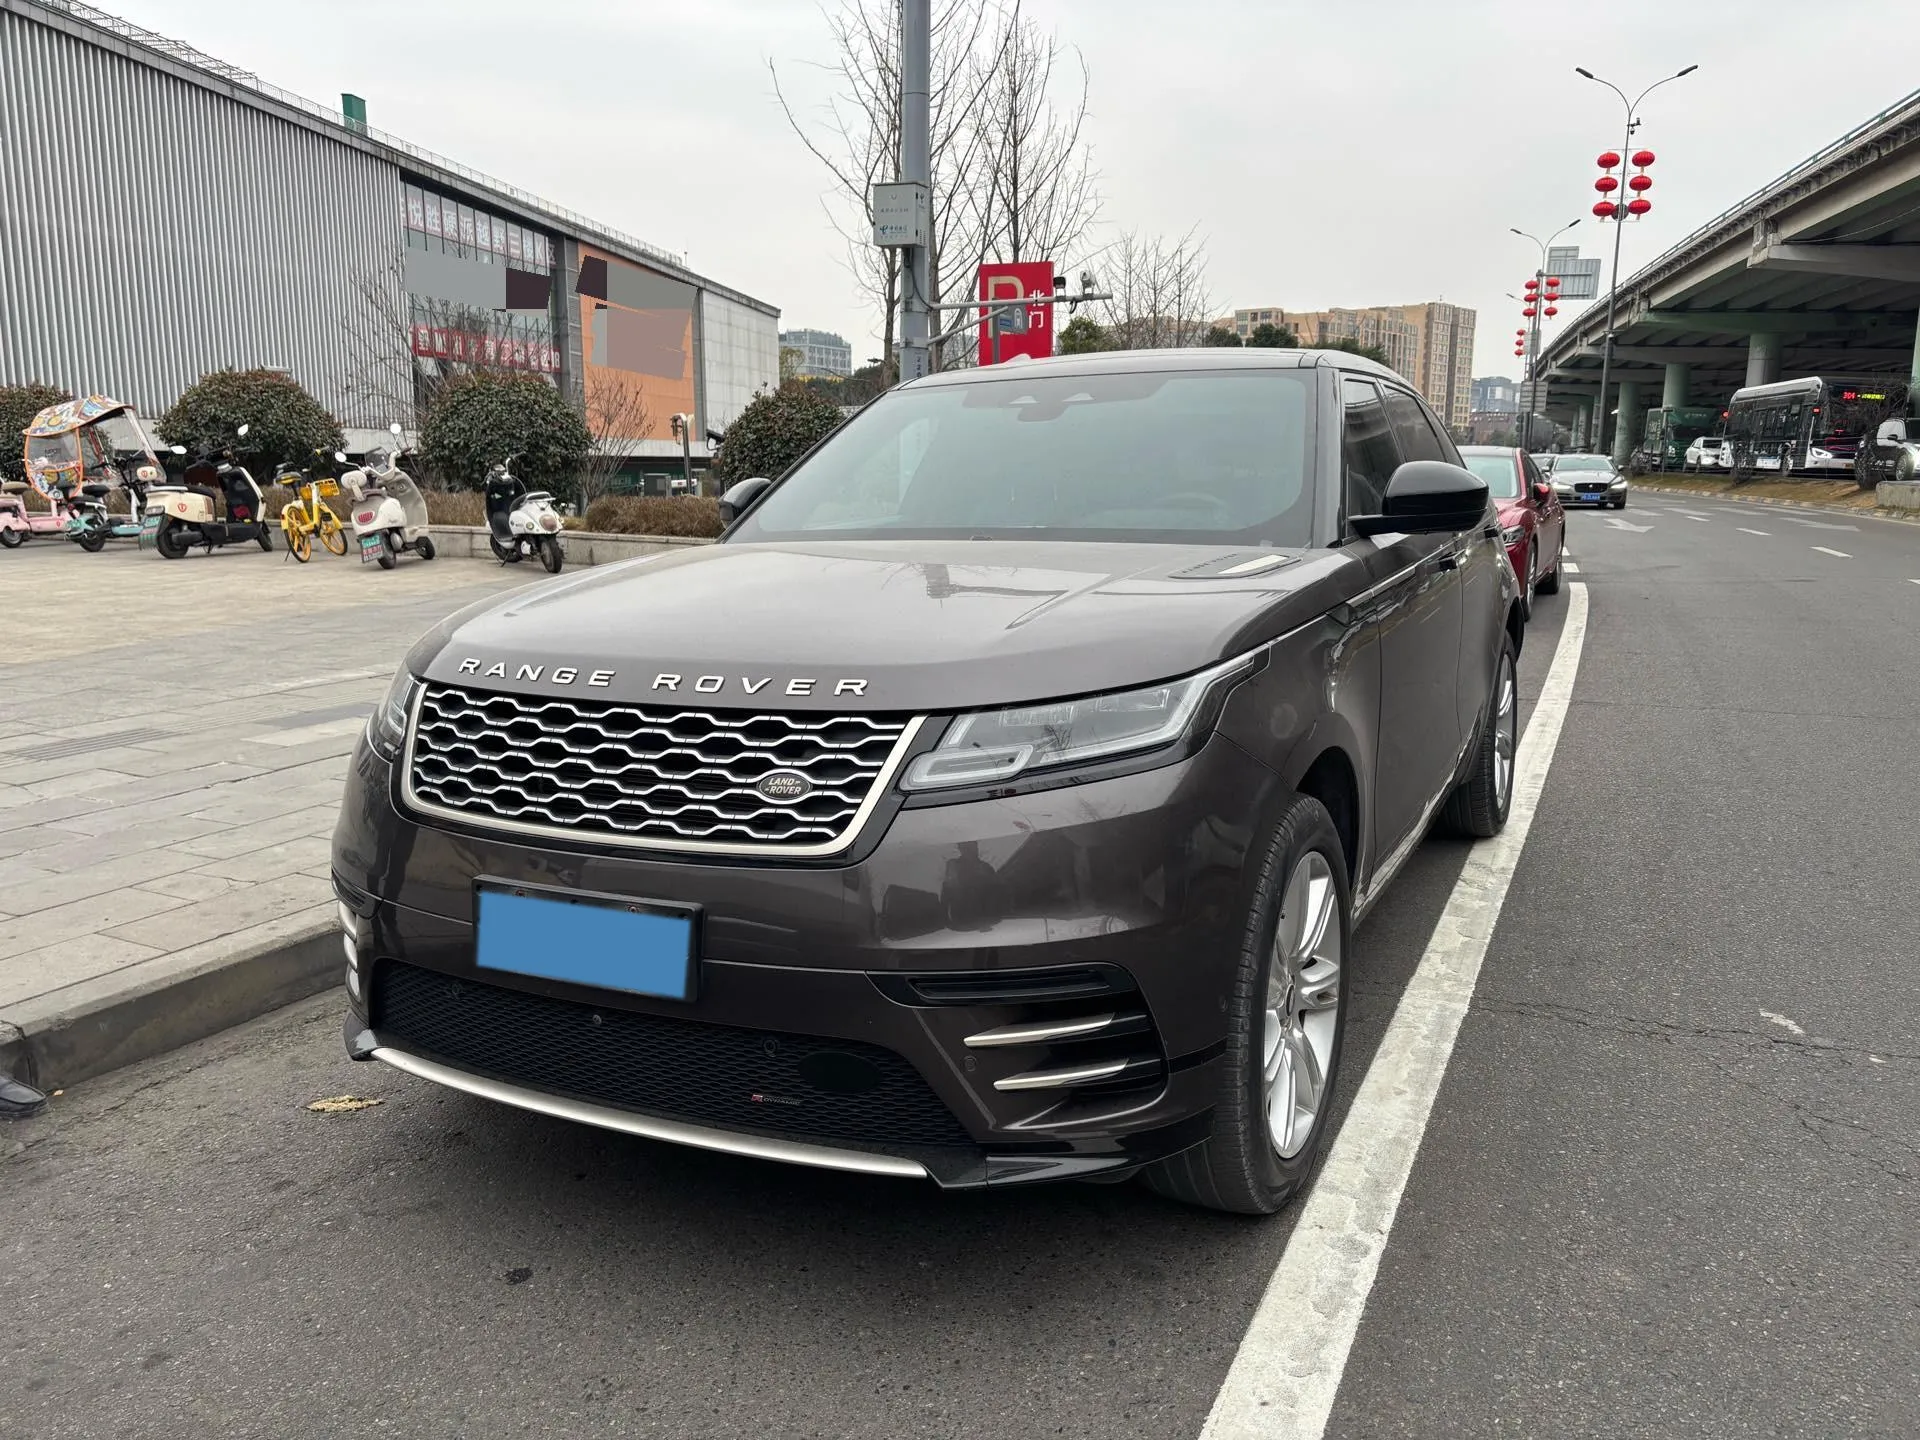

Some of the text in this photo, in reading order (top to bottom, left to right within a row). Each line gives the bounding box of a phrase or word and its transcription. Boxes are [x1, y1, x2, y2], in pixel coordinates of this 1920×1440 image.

[1028, 289, 1045, 329] 北门
[457, 656, 869, 697] RANGE ROVER
